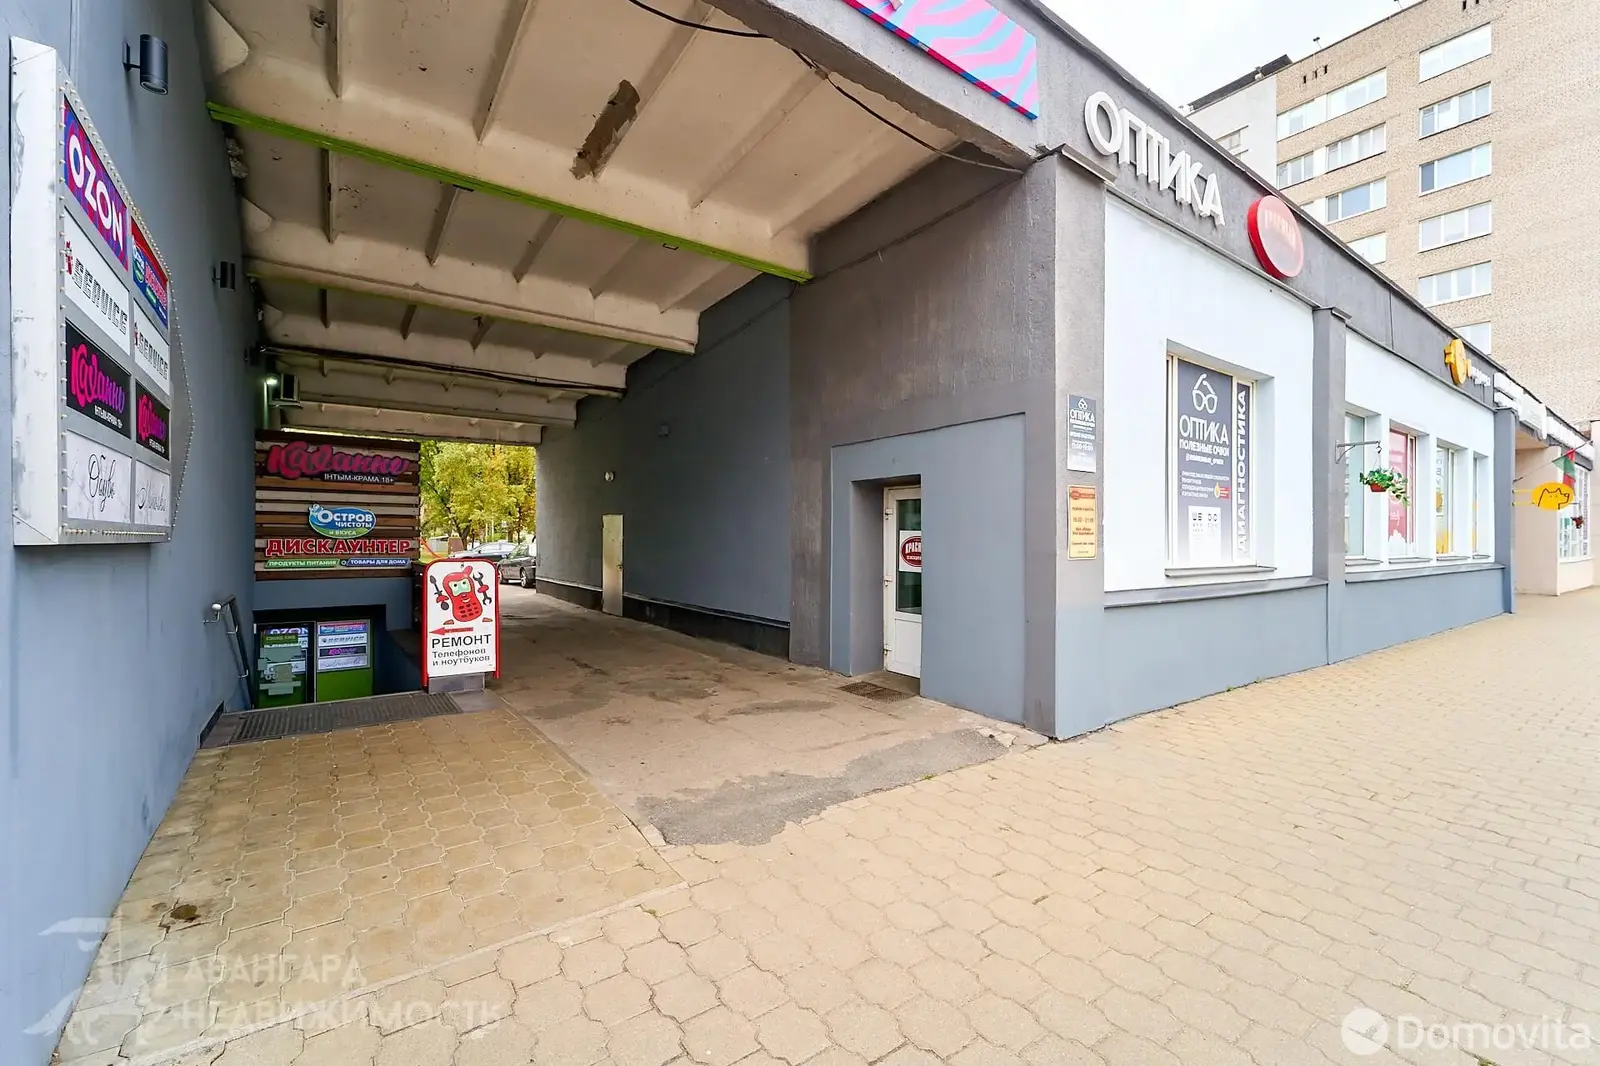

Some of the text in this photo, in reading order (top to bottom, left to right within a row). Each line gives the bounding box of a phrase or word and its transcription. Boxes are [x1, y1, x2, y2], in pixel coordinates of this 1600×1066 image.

[1084, 91, 1225, 226] ОПТИКА
[69, 134, 123, 250] OZON
[1070, 409, 1095, 423] ОПТИКА
[1180, 415, 1229, 445] ОПТИКА
[1180, 439, 1229, 457] ПОЛЕЗНЫЕ ОЧКИ
[381, 476, 394, 484] 18+
[1237, 391, 1247, 553] ДИАГНОСТИКА
[265, 538, 412, 557] ДИСКАУНТЕР
[431, 634, 492, 649] РЕМОНТ
[432, 648, 486, 658] Телефонов
[441, 655, 490, 666] ноутбуков
